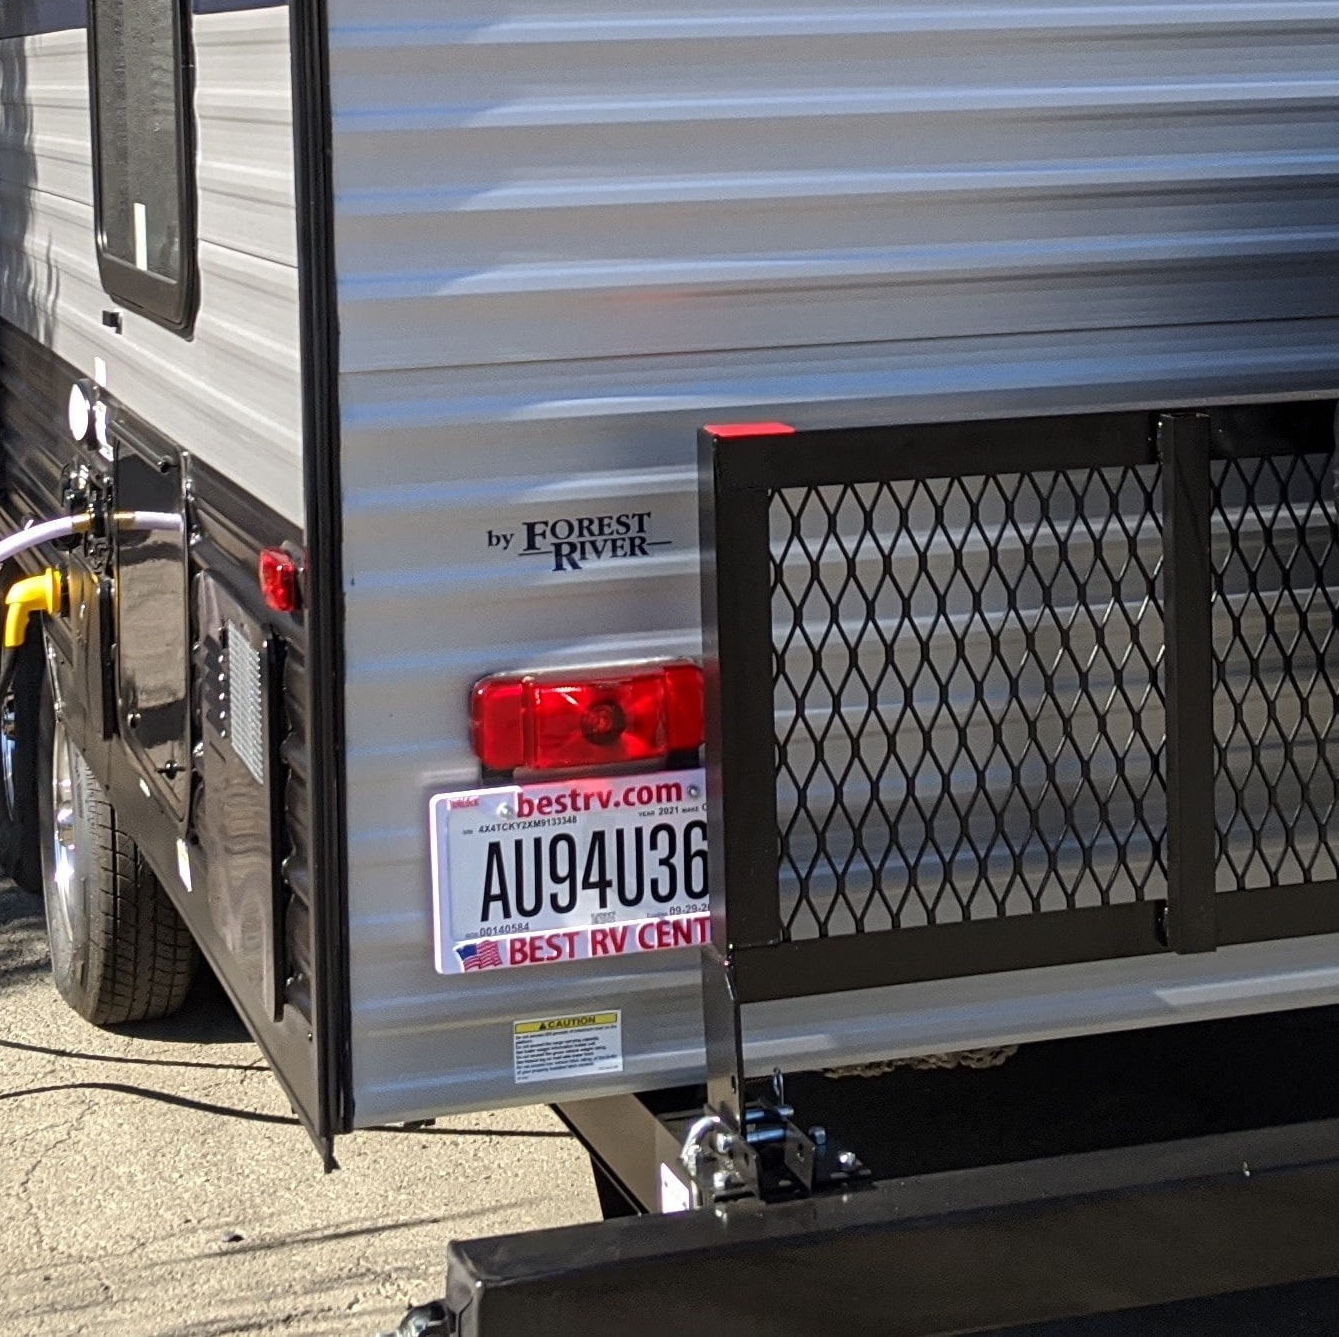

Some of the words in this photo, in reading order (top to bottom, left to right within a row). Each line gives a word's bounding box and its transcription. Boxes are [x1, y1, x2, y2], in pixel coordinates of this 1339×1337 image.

[487, 530, 514, 550] by
[522, 511, 652, 552] FOREST
[551, 536, 650, 572] RIVER
[517, 781, 682, 818] bestrv.com
[658, 805, 679, 816] 2021
[480, 820, 709, 922] AU94U36
[669, 903, 710, 915] 09-29-2
[480, 922, 529, 937] 00140584
[510, 931, 581, 965] BEST
[590, 927, 629, 956] RV
[548, 1016, 596, 1029] CAUTION
